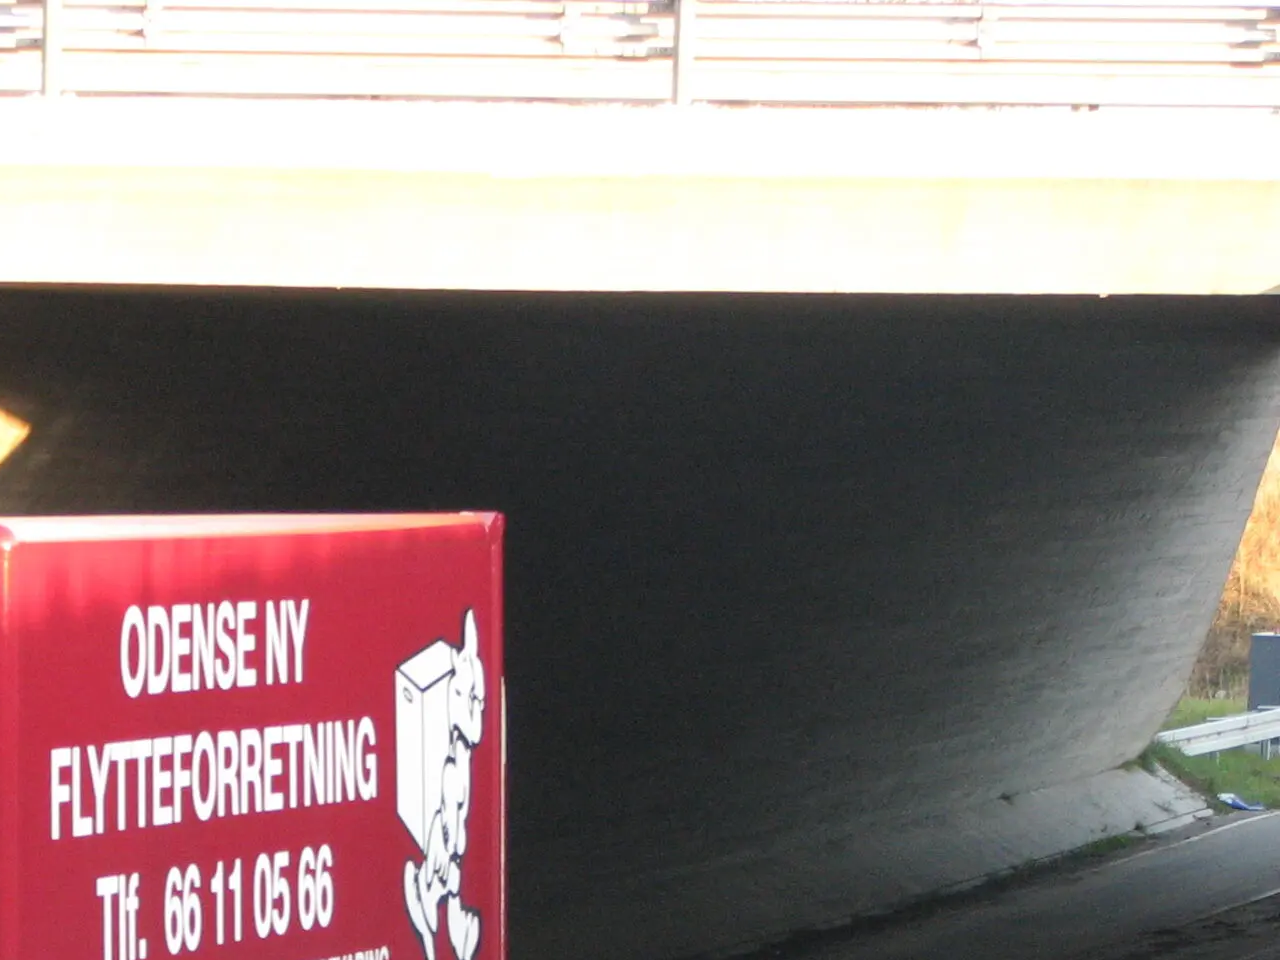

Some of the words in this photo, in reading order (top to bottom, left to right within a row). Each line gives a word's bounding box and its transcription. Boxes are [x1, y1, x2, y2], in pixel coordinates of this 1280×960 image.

[120, 600, 257, 699] ODENSE
[266, 599, 310, 685] NY
[50, 716, 378, 840] FLYTTEFORRETNING
[164, 864, 203, 956] 66
[211, 858, 242, 945] 11
[254, 850, 291, 938] 05
[298, 844, 334, 930] 66
